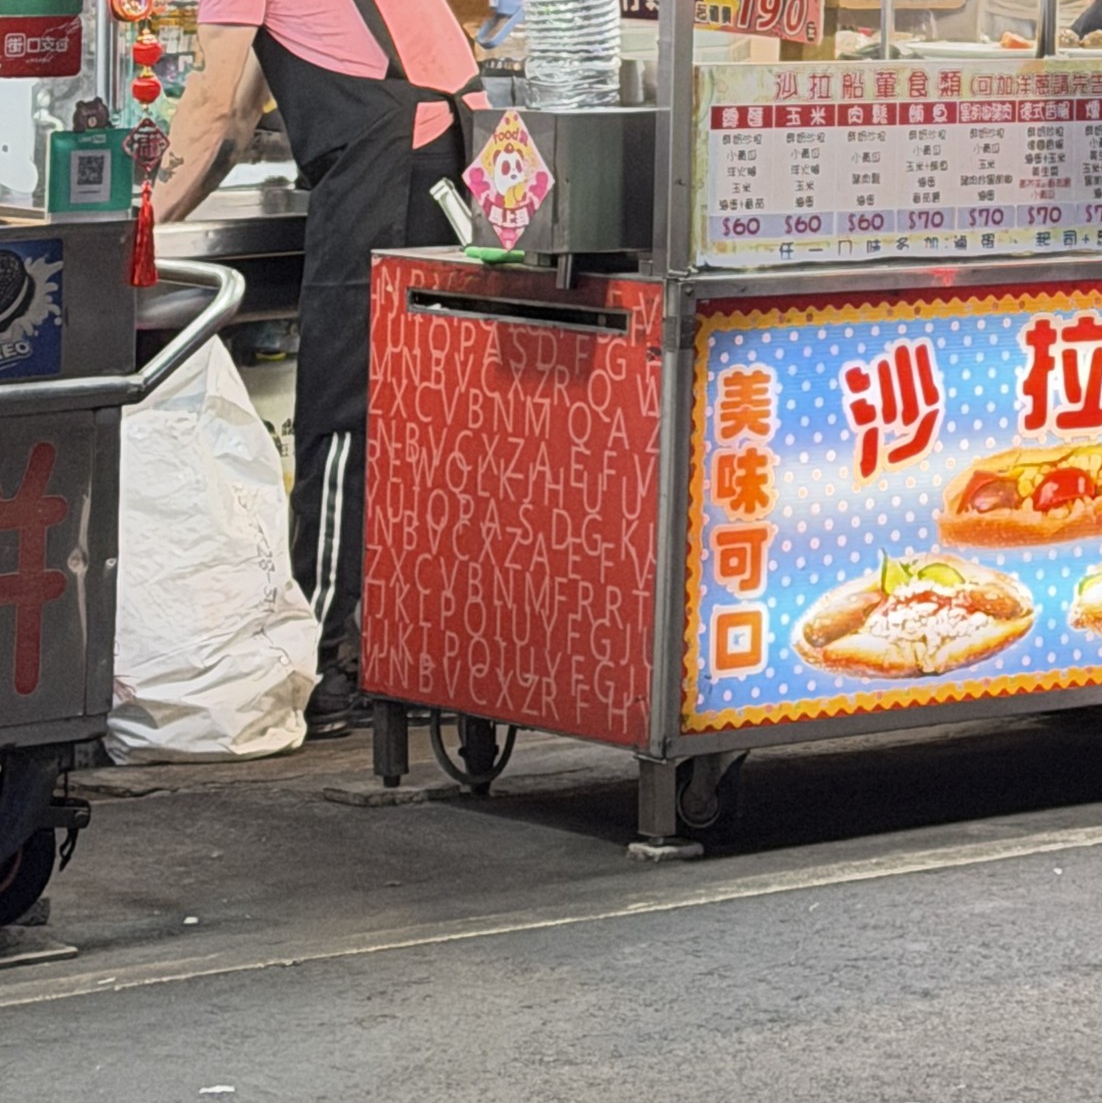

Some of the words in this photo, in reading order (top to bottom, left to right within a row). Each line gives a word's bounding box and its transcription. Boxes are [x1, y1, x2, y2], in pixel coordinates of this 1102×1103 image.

[784, 106, 828, 126] 玉米
[713, 369, 775, 673] 美味可口
